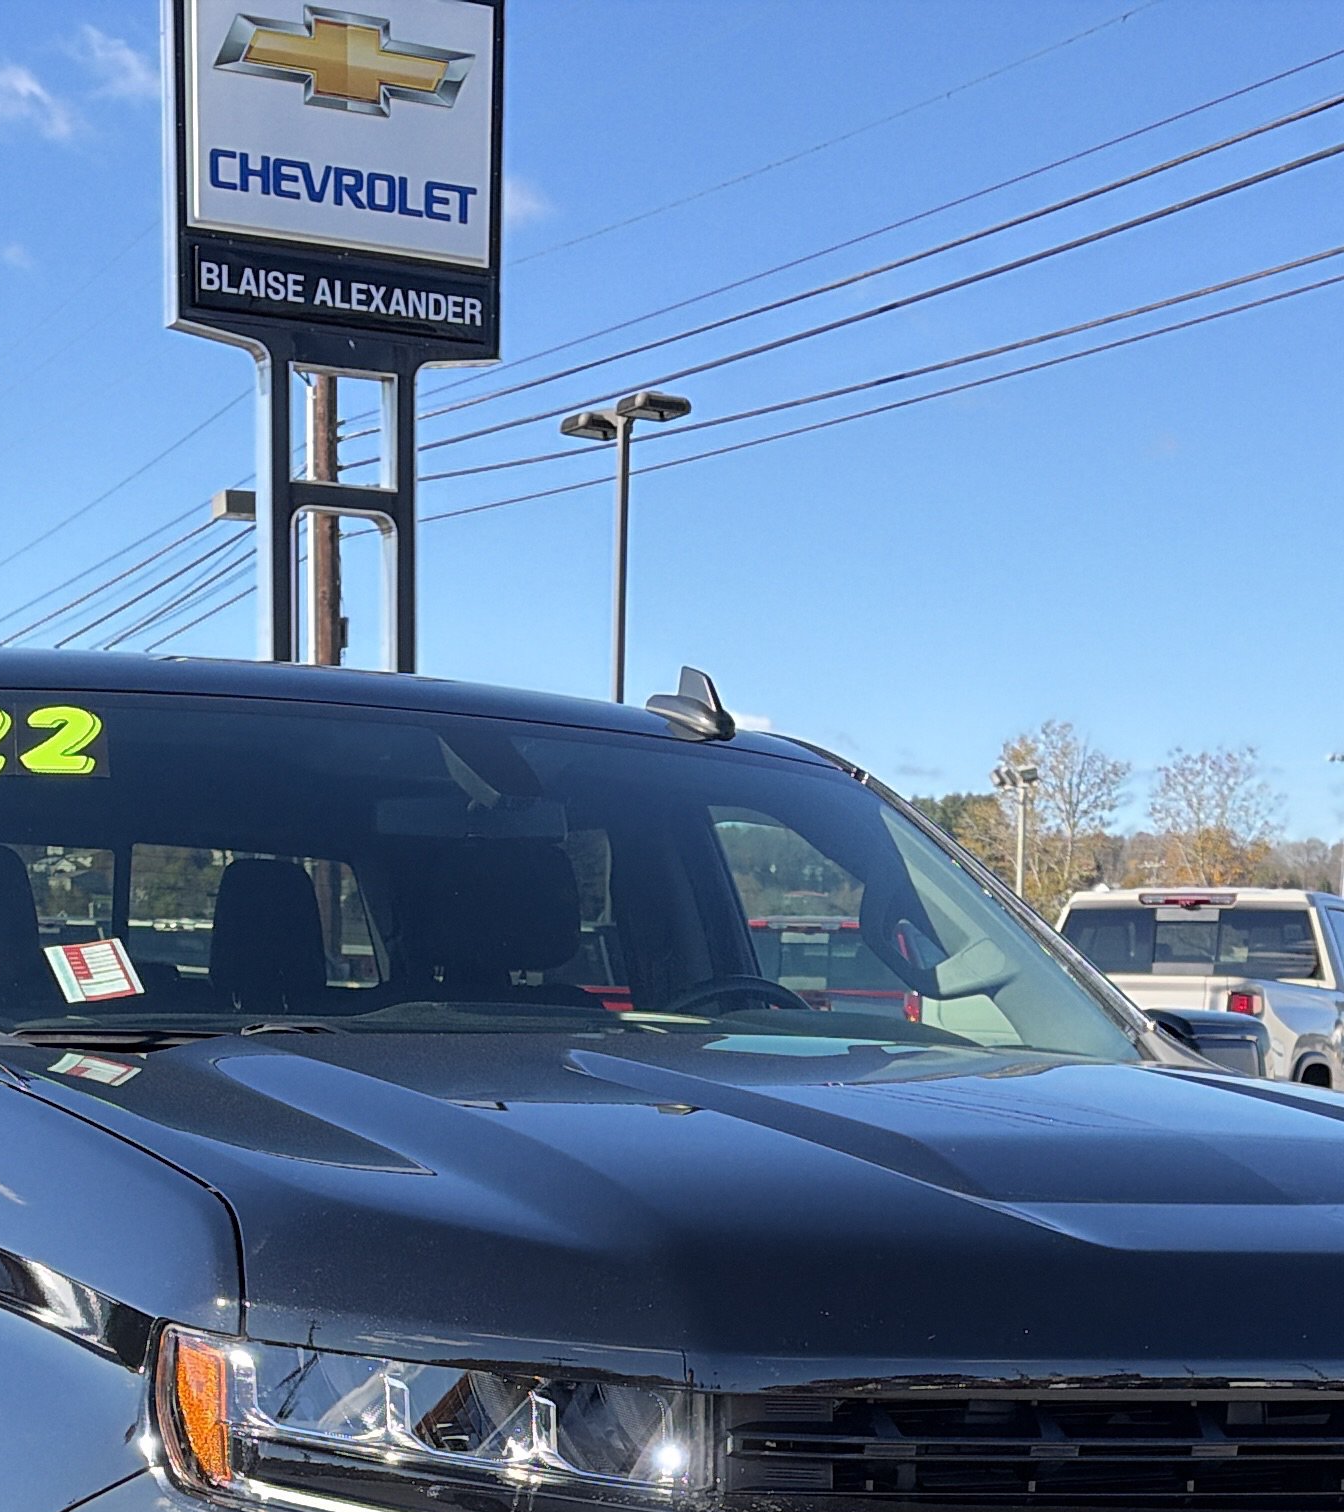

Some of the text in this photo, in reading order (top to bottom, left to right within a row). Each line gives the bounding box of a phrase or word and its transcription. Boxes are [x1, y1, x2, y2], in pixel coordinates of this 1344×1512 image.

[209, 147, 478, 225] CHEVROLET
[200, 261, 483, 327] BLAISE ALEXANDER
